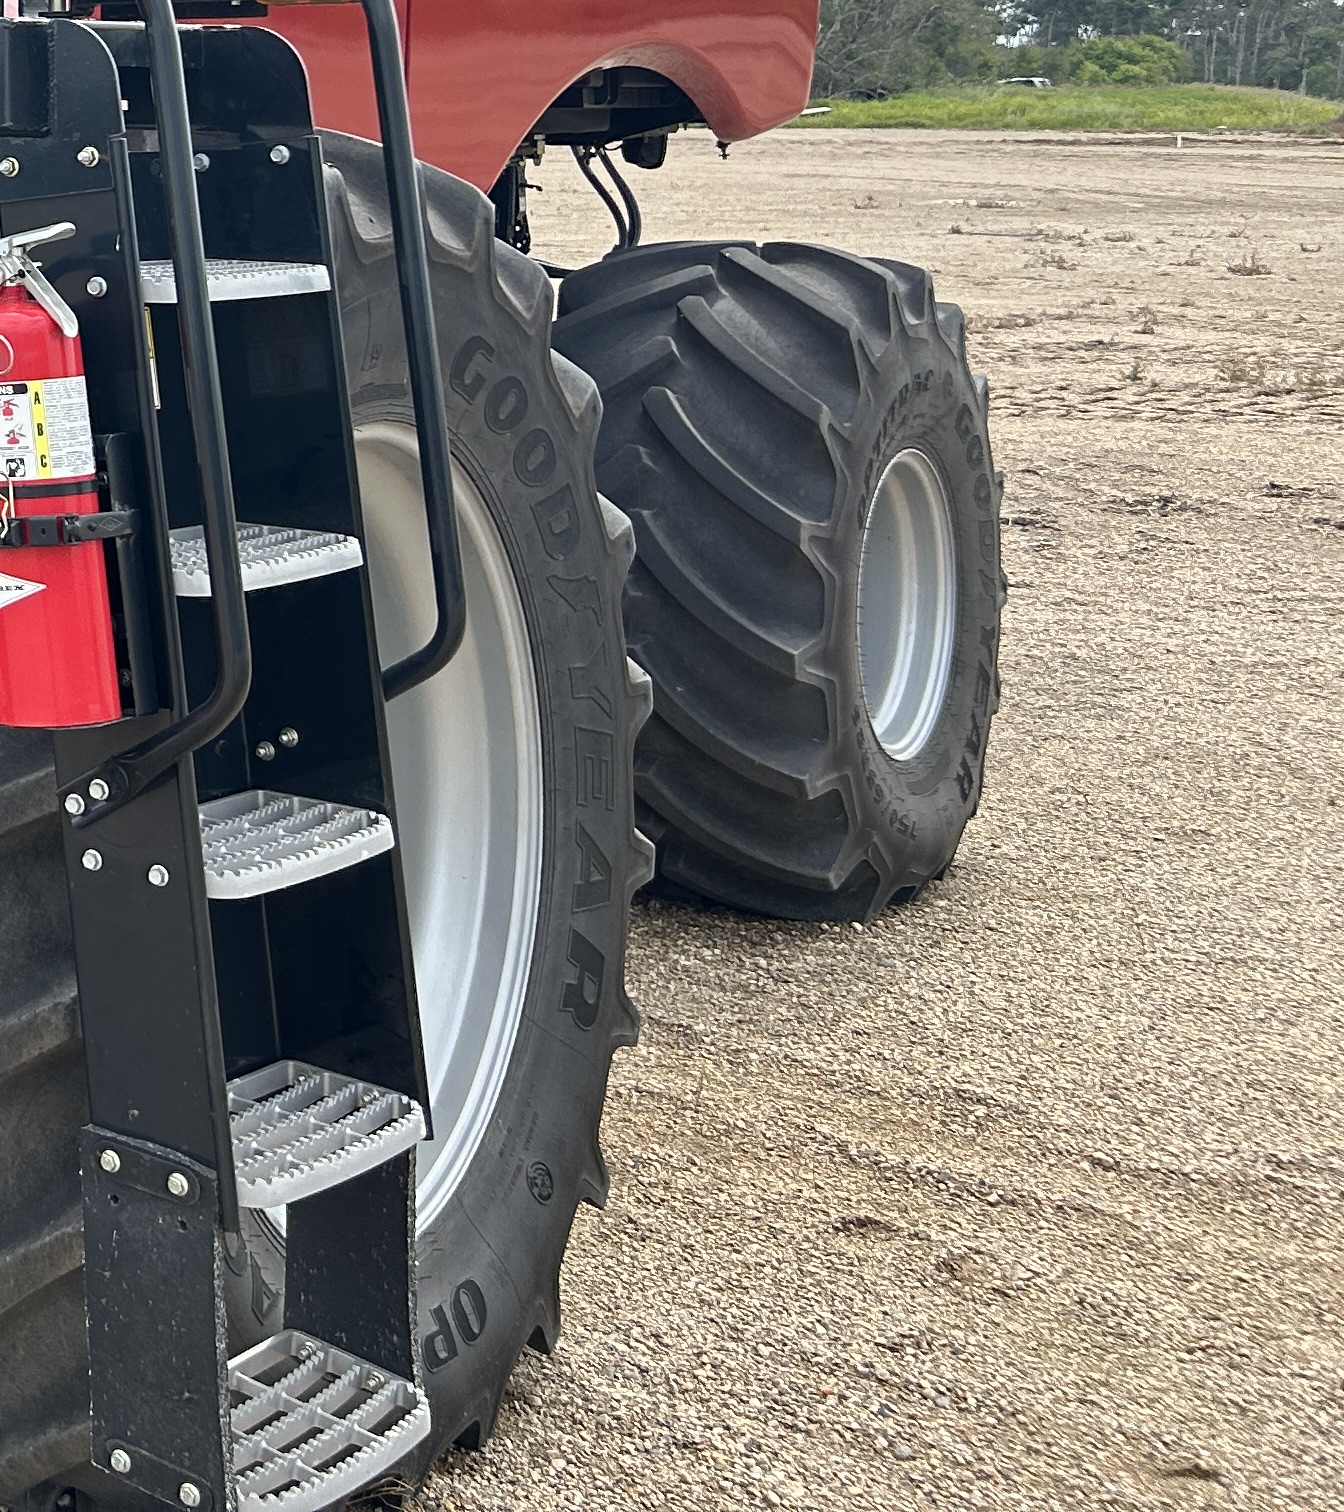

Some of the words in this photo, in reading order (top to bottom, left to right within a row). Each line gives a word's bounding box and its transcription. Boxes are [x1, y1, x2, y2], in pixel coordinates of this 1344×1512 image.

[33, 391, 42, 406] A
[36, 422, 44, 437] B
[40, 454, 48, 468] C
